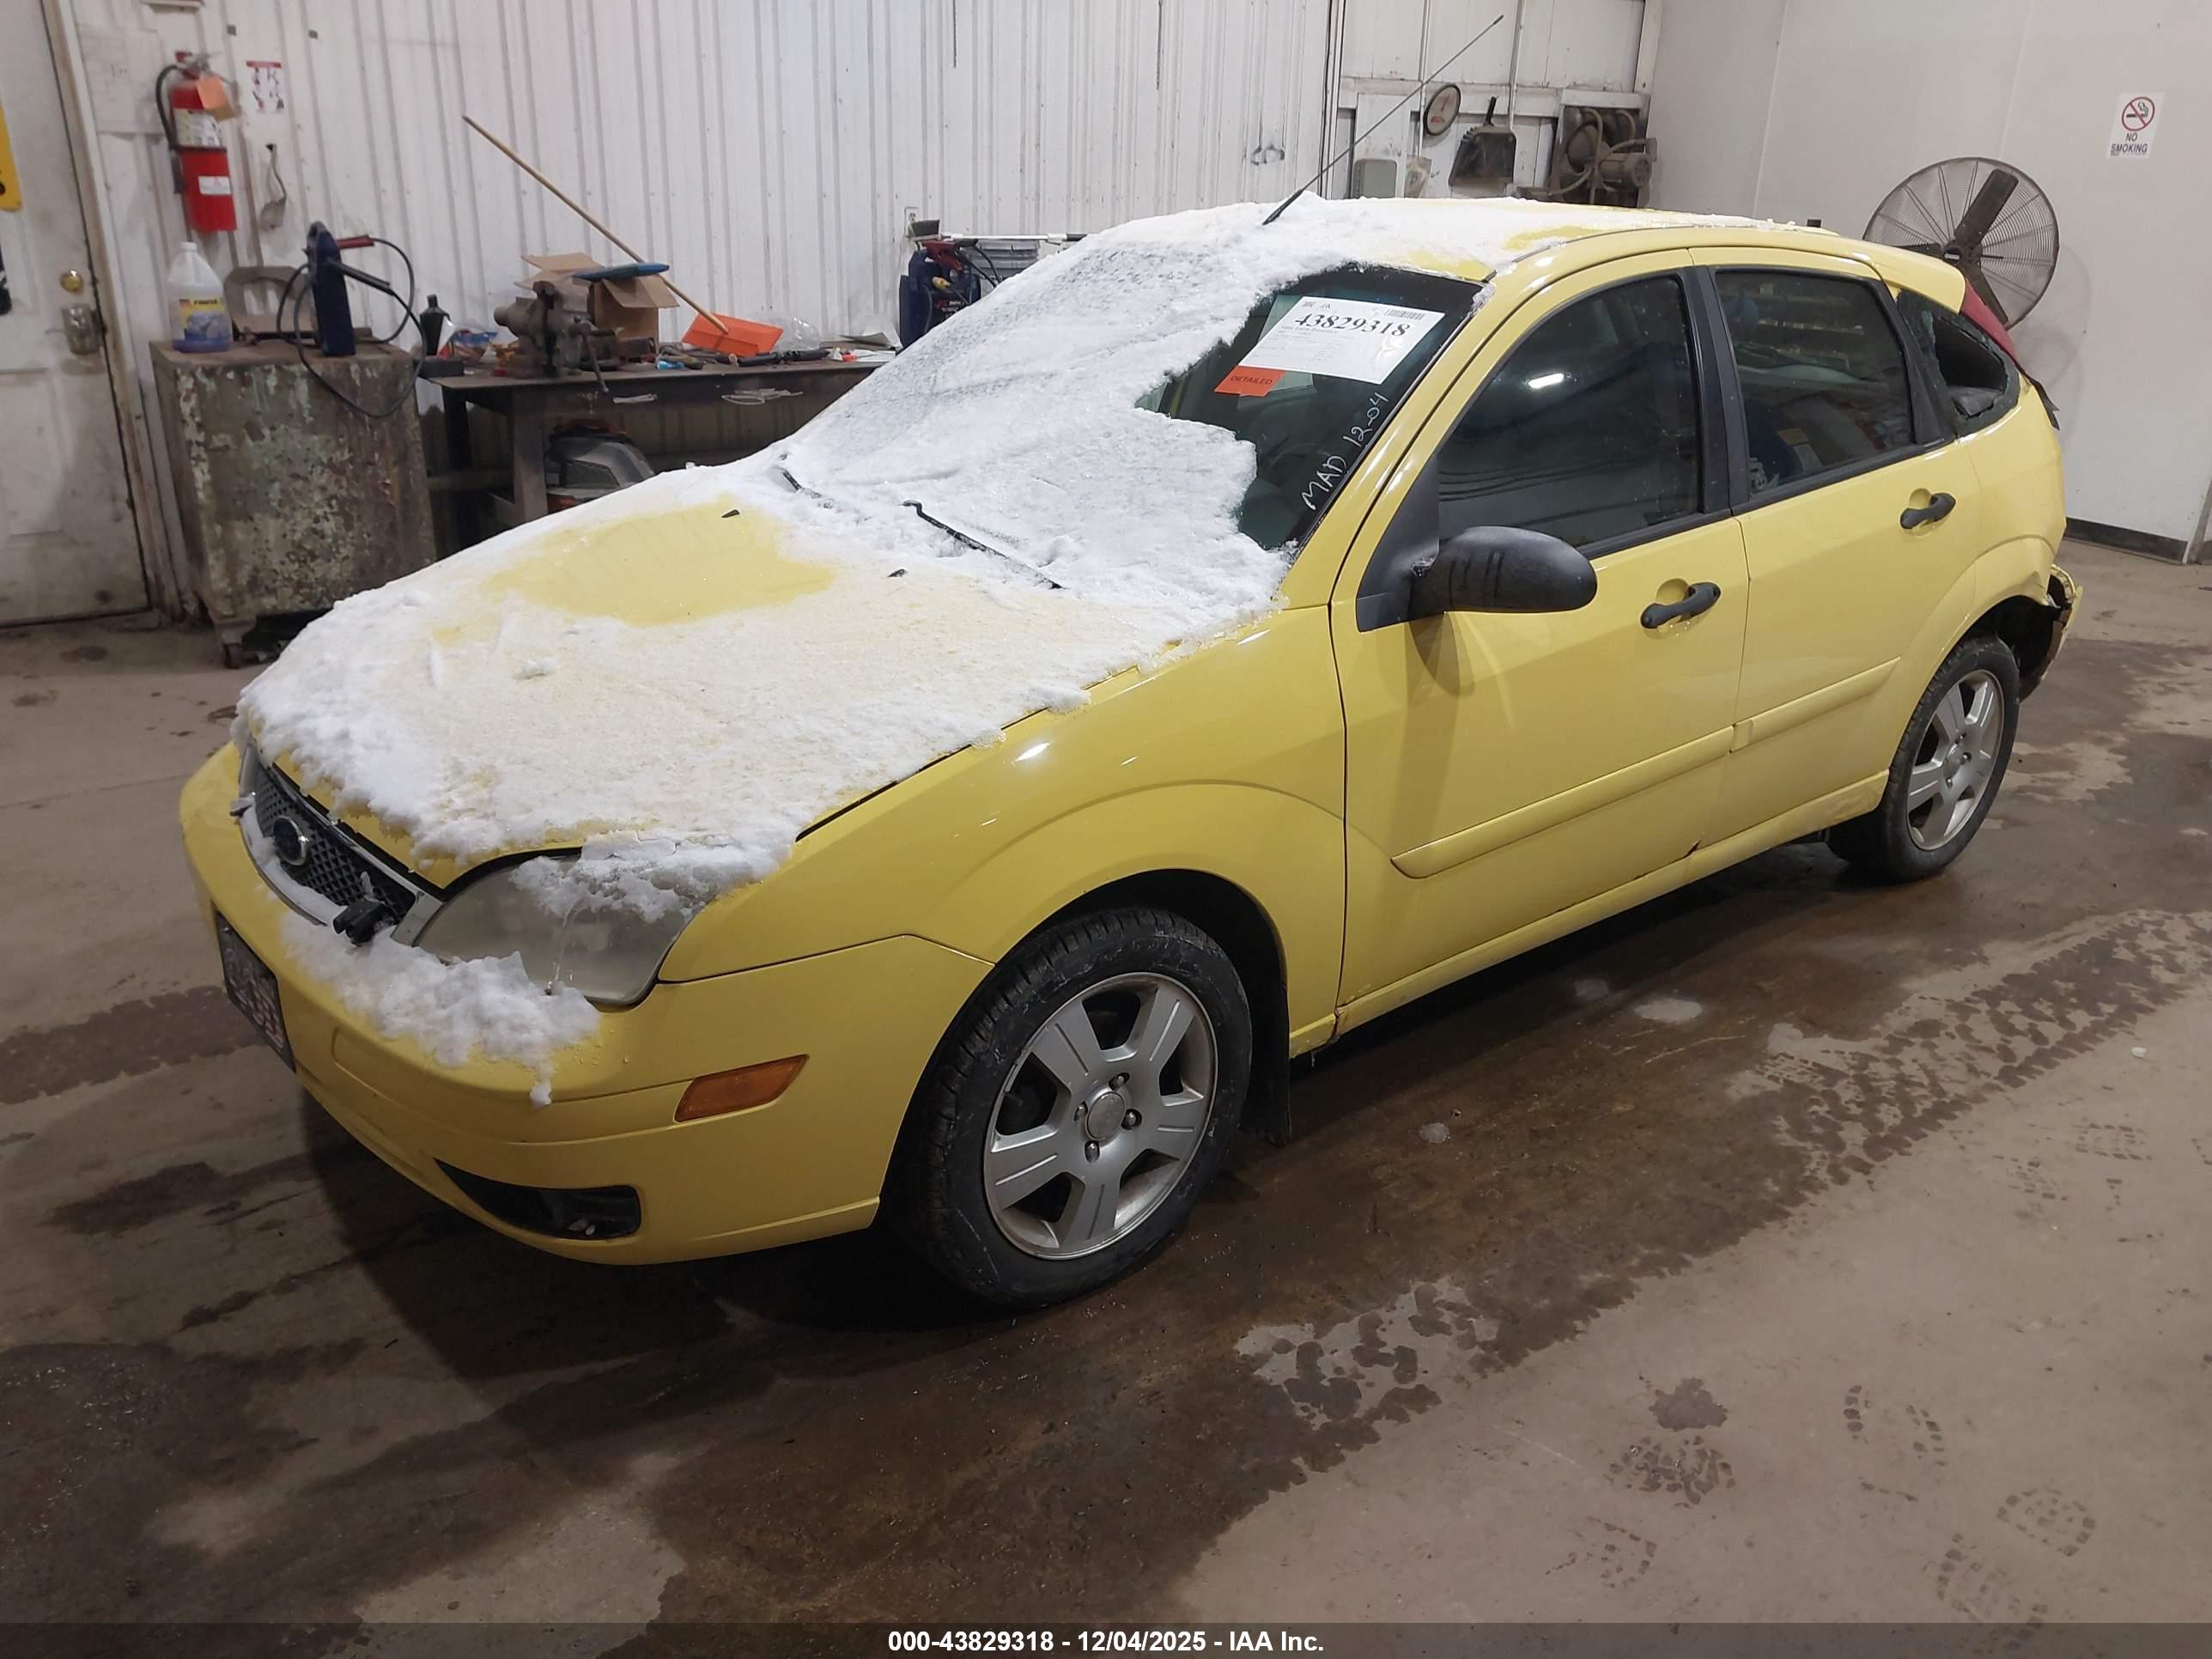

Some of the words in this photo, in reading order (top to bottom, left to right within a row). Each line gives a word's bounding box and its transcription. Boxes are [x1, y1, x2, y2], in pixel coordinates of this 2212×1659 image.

[2125, 132, 2138, 142] NO
[2111, 143, 2148, 153] SMOKING
[1295, 313, 1411, 337] 43829318
[1231, 374, 1273, 385] DETAILED
[1301, 455, 1347, 510] MAD
[1342, 392, 1389, 447] 12-04
